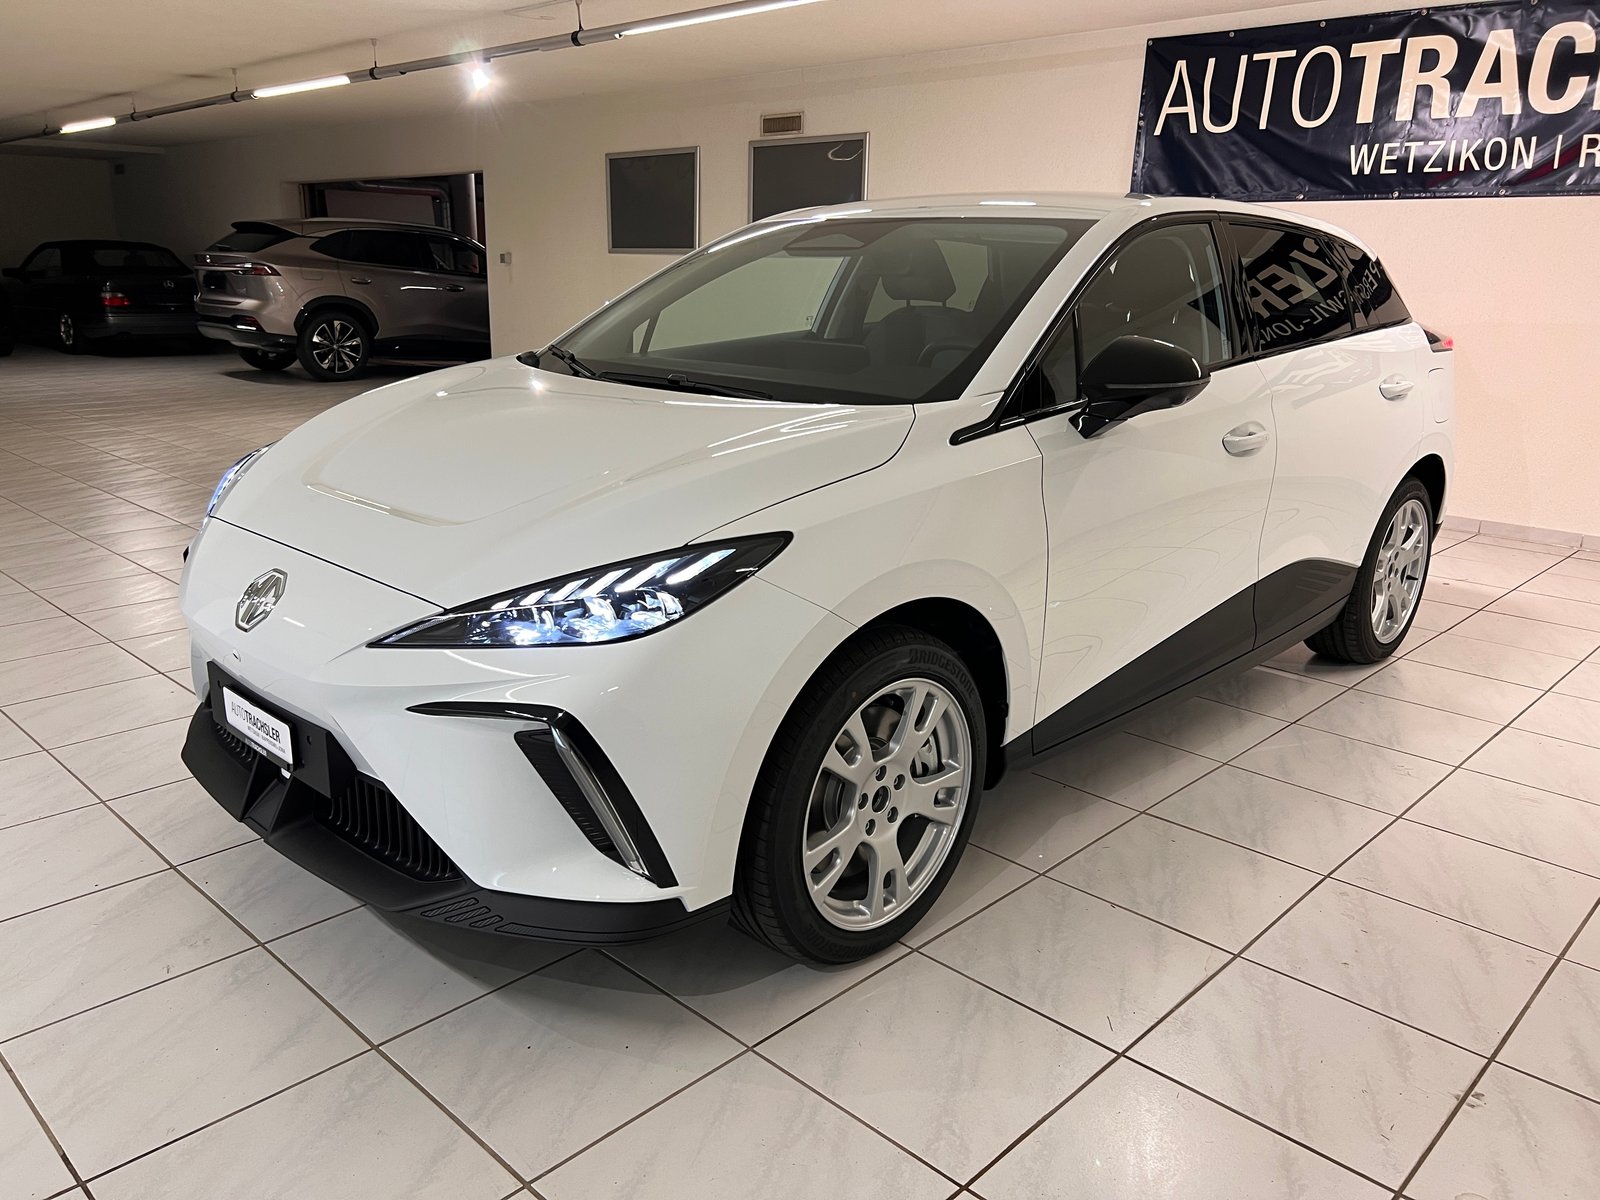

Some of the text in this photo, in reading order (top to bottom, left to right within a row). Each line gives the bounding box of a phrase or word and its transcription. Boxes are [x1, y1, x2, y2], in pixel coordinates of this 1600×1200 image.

[1153, 21, 1600, 136] AUTOTRAC
[1350, 136, 1537, 175] WETZIKON
[907, 647, 976, 698] BRIDGESTONE
[231, 701, 281, 744] AUTOTRACHSLER
